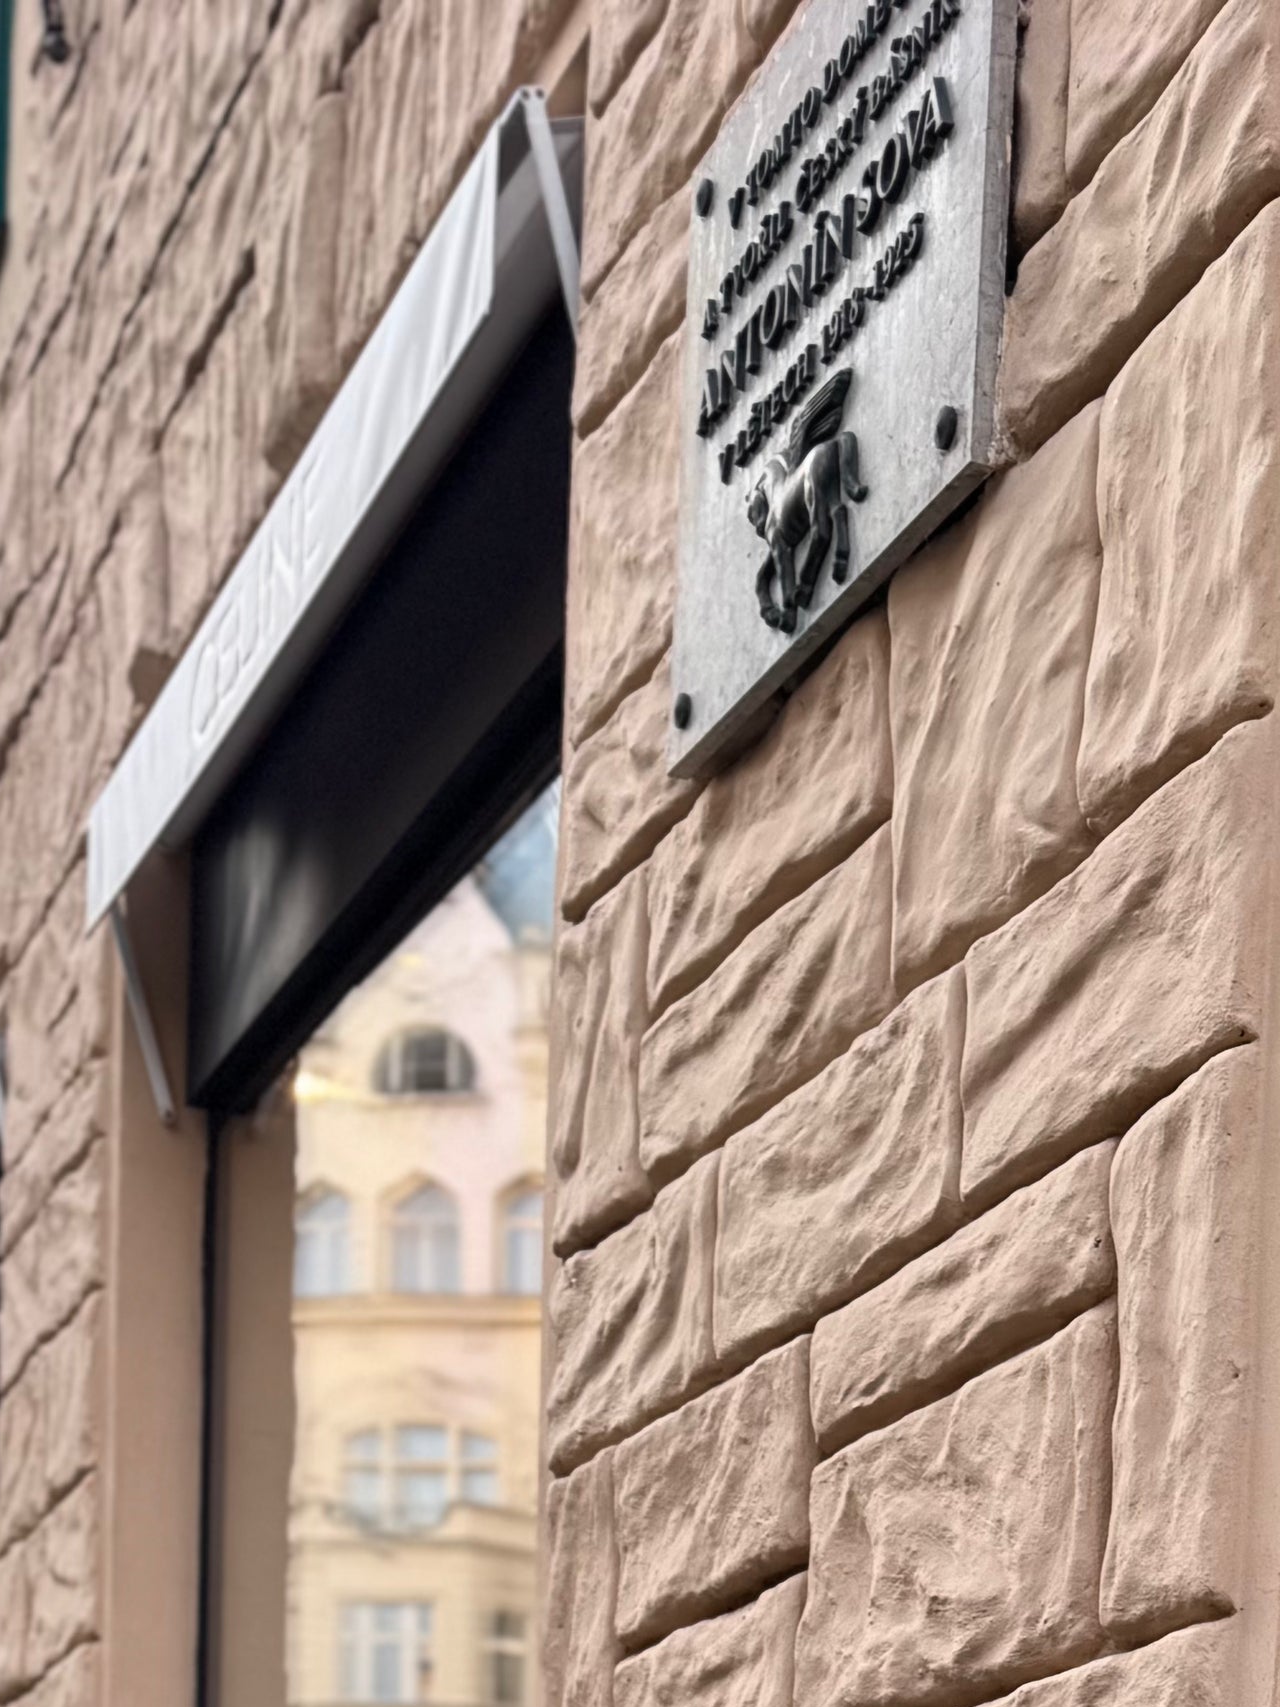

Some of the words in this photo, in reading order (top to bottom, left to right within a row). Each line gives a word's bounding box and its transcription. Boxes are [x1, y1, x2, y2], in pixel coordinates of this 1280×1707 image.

[696, 194, 856, 438] ANTONÍN
[856, 77, 954, 236] SOVA
[701, 298, 719, 340] A
[795, 86, 868, 213] ČESKÝ
[728, 187, 746, 229] V
[746, 87, 821, 206] TOMTO
[718, 443, 735, 486] V
[189, 446, 324, 747] CELINE
